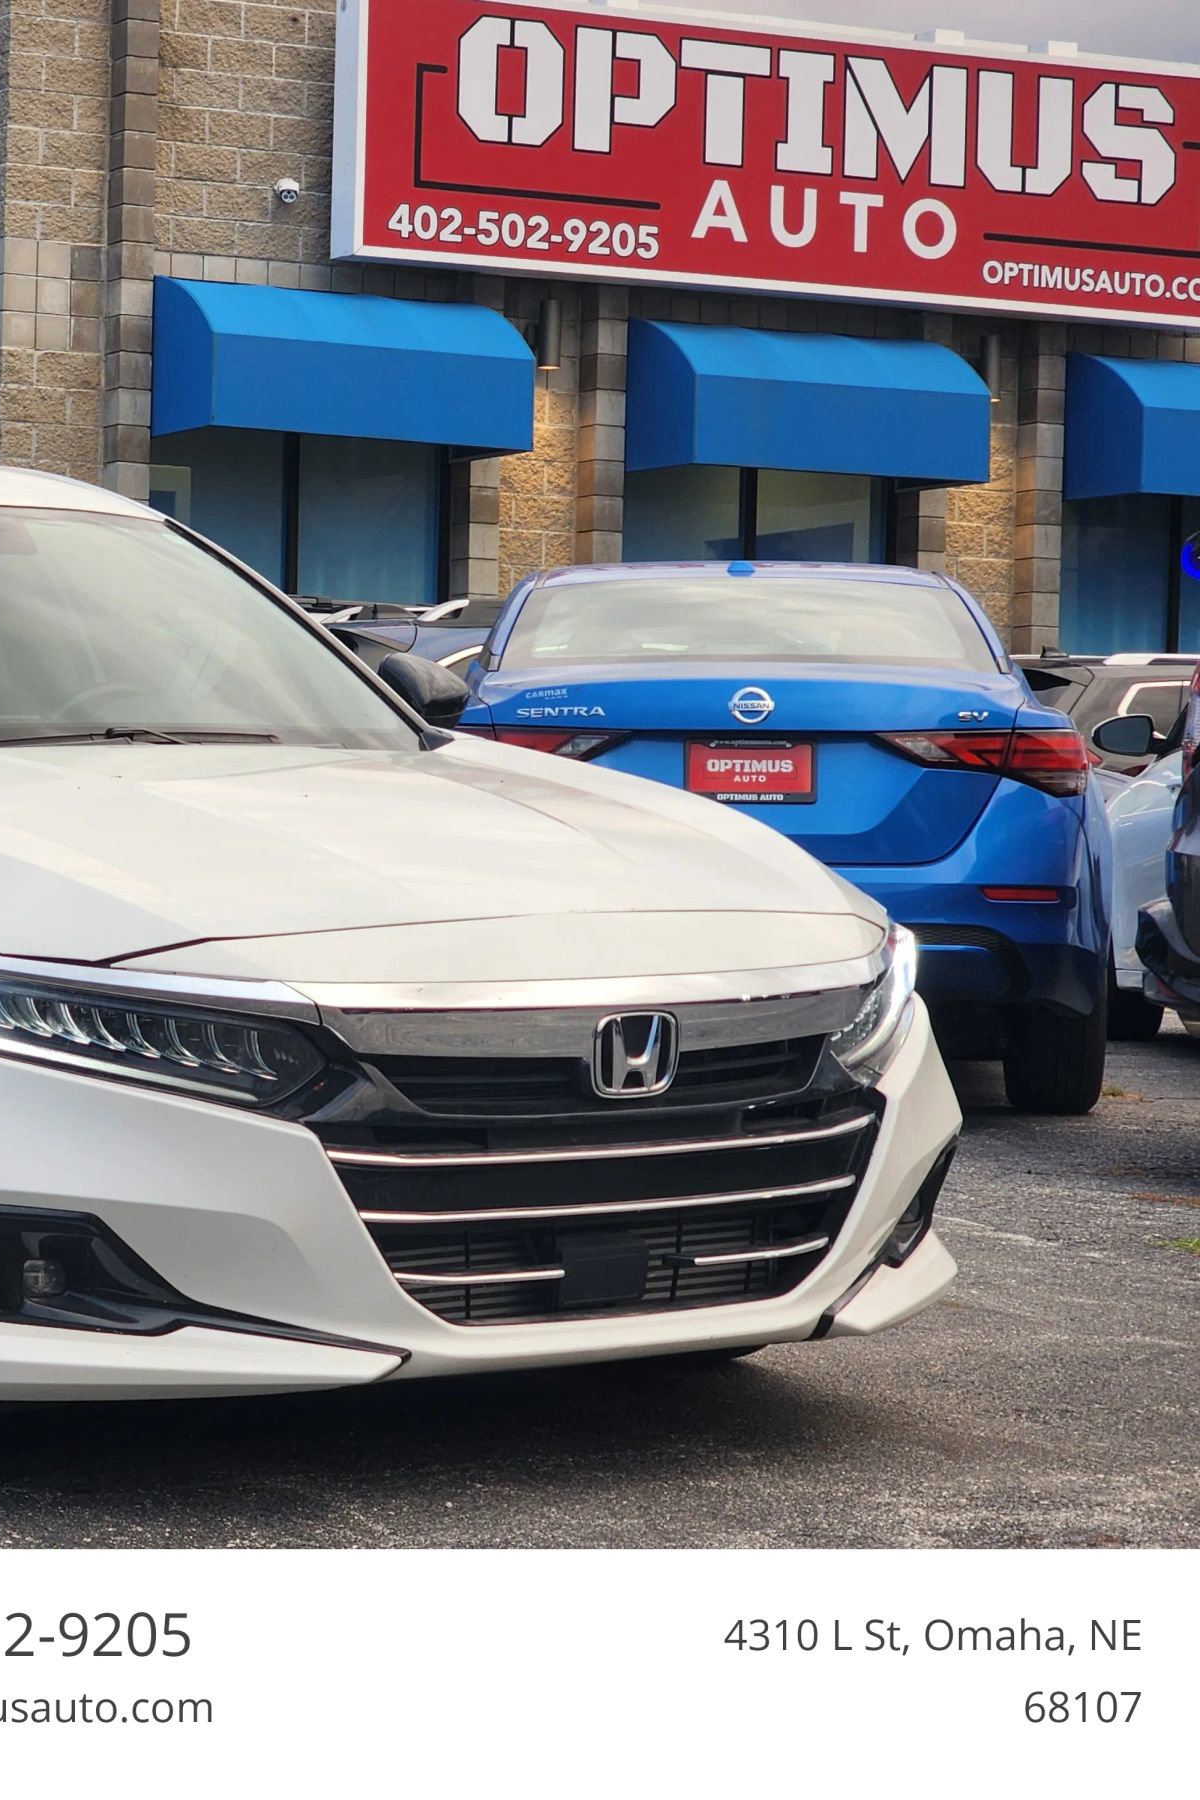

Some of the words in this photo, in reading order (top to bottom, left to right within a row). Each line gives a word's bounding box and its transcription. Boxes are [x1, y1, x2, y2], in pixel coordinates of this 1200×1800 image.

[456, 14, 1178, 206] OPTIMUS
[690, 179, 957, 260] AUTO
[387, 203, 661, 260] 402-502-9205
[515, 705, 606, 719] SENTRA
[732, 702, 771, 710] NISSAN
[957, 710, 989, 721] SV
[706, 759, 794, 773] OPTIMUS
[733, 774, 767, 783] AUTO
[716, 793, 758, 801] OPTIMUS
[759, 793, 784, 801] AUTO
